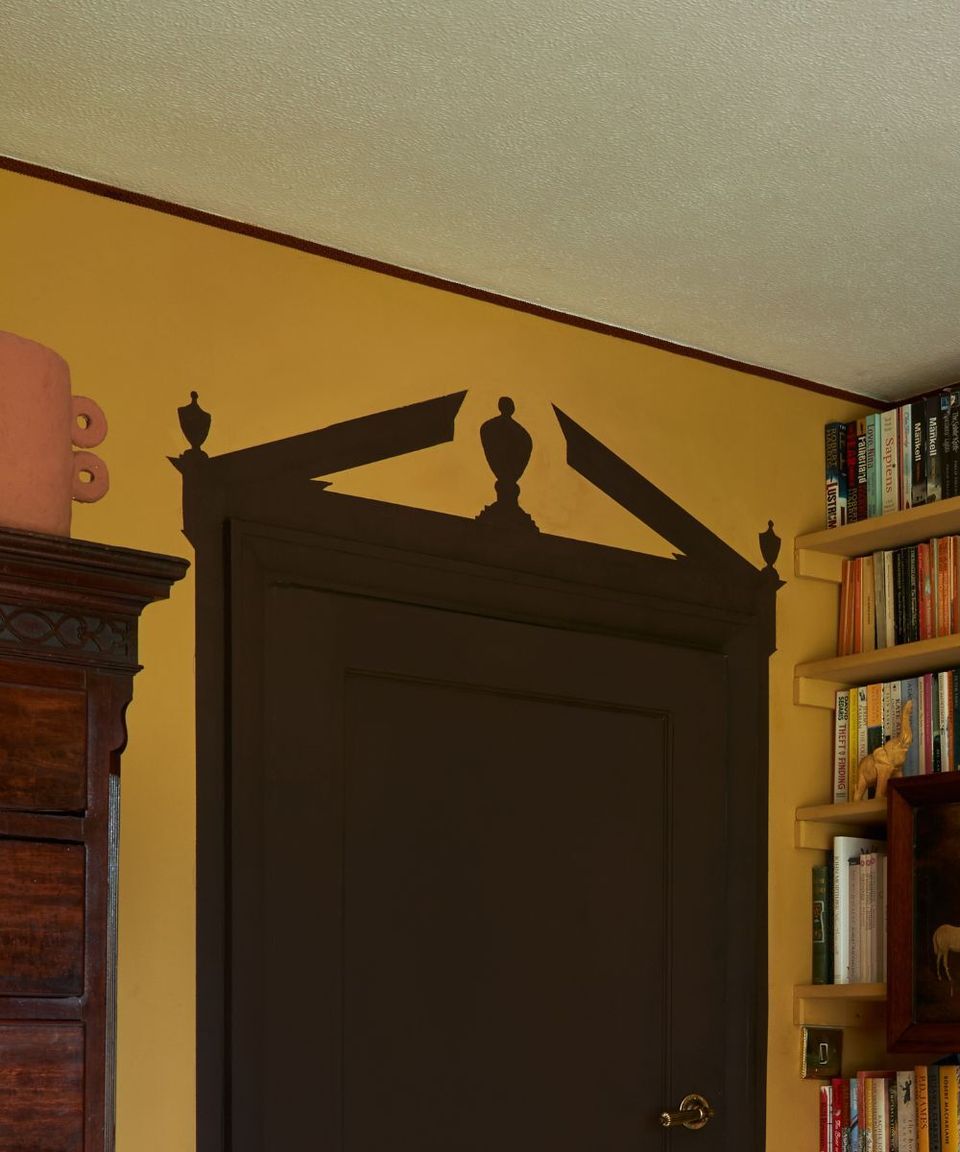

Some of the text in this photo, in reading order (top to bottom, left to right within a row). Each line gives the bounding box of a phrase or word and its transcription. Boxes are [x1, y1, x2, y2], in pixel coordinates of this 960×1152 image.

[914, 422, 922, 462] Mankell
[929, 417, 937, 457] Mankell
[883, 437, 895, 493] Sapiens
[839, 724, 847, 790] THEFT FINDING
[919, 1095, 927, 1129] JAMES
